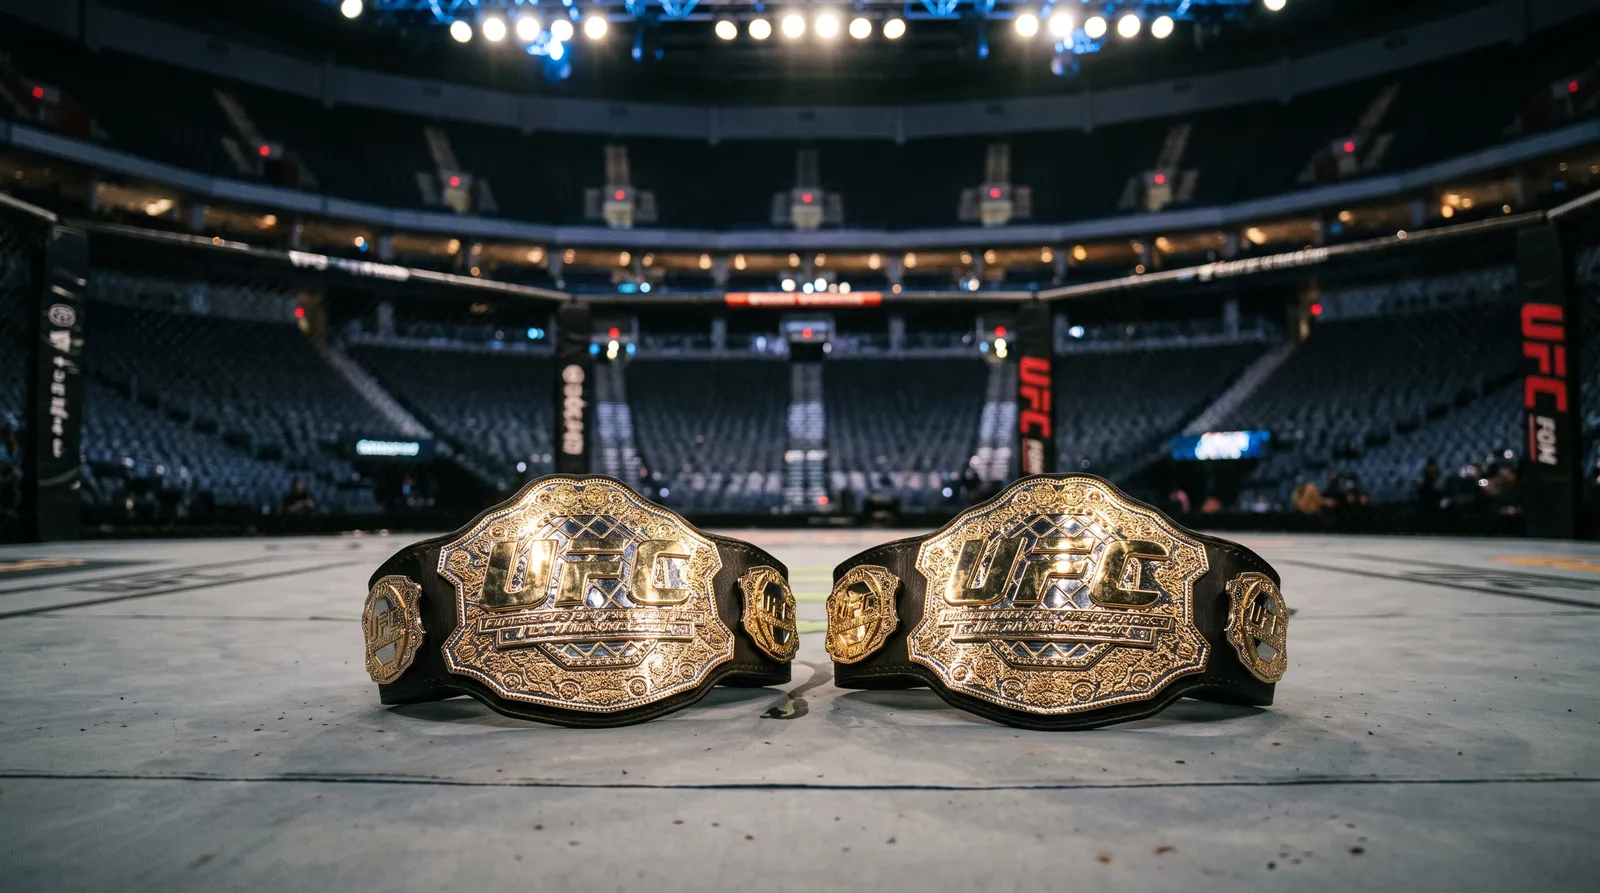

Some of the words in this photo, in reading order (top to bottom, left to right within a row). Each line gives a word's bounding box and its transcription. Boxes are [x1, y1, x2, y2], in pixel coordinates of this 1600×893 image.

[1520, 303, 1568, 412] UFC
[1019, 356, 1051, 437] UFC
[479, 538, 691, 611] UFC
[834, 591, 876, 623] UFC
[943, 536, 1169, 608] UFC
[368, 606, 400, 643] UFC
